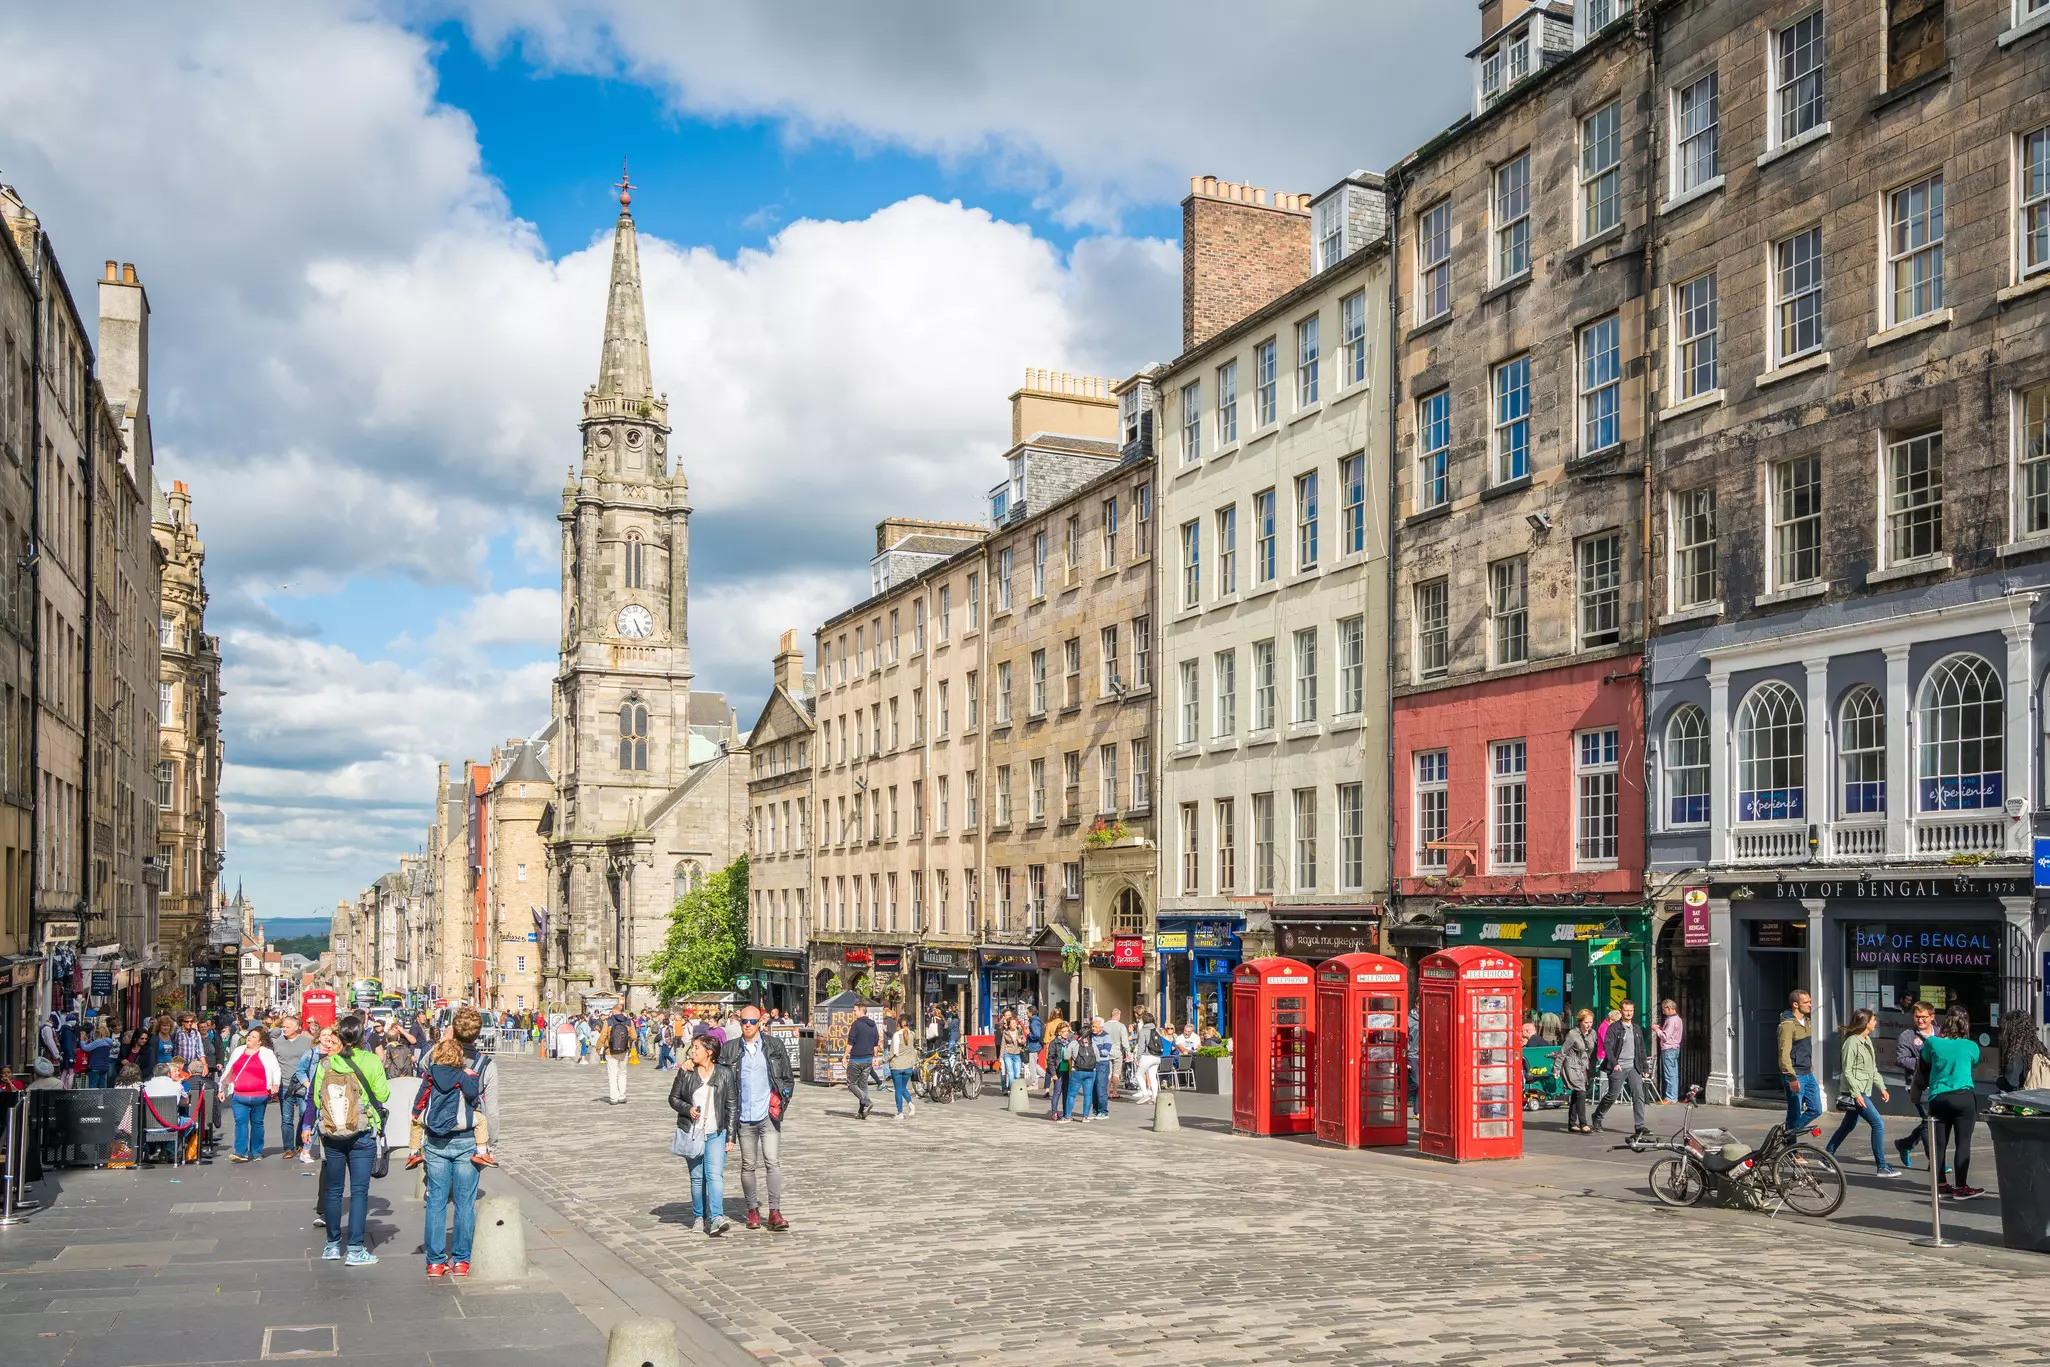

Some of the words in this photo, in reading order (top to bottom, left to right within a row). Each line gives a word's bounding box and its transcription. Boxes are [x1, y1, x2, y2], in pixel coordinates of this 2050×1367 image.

[1777, 883, 1808, 898] BAY
[1820, 882, 1843, 897] OF
[1857, 880, 1940, 897] BENGAL
[1987, 882, 2016, 893] 1978
[1479, 922, 1528, 940] SUBWAY
[1856, 932, 1885, 946] BAY
[1891, 934, 1913, 949] OF
[1920, 933, 1992, 949] BENGAL
[1856, 951, 1900, 962] INDIAN
[1903, 952, 1992, 966] RESTAURANT
[1469, 970, 1512, 978] TELEPHONE
[772, 1030, 792, 1038] PUB
[828, 1024, 851, 1037] GHO
[829, 1037, 848, 1051] TO
